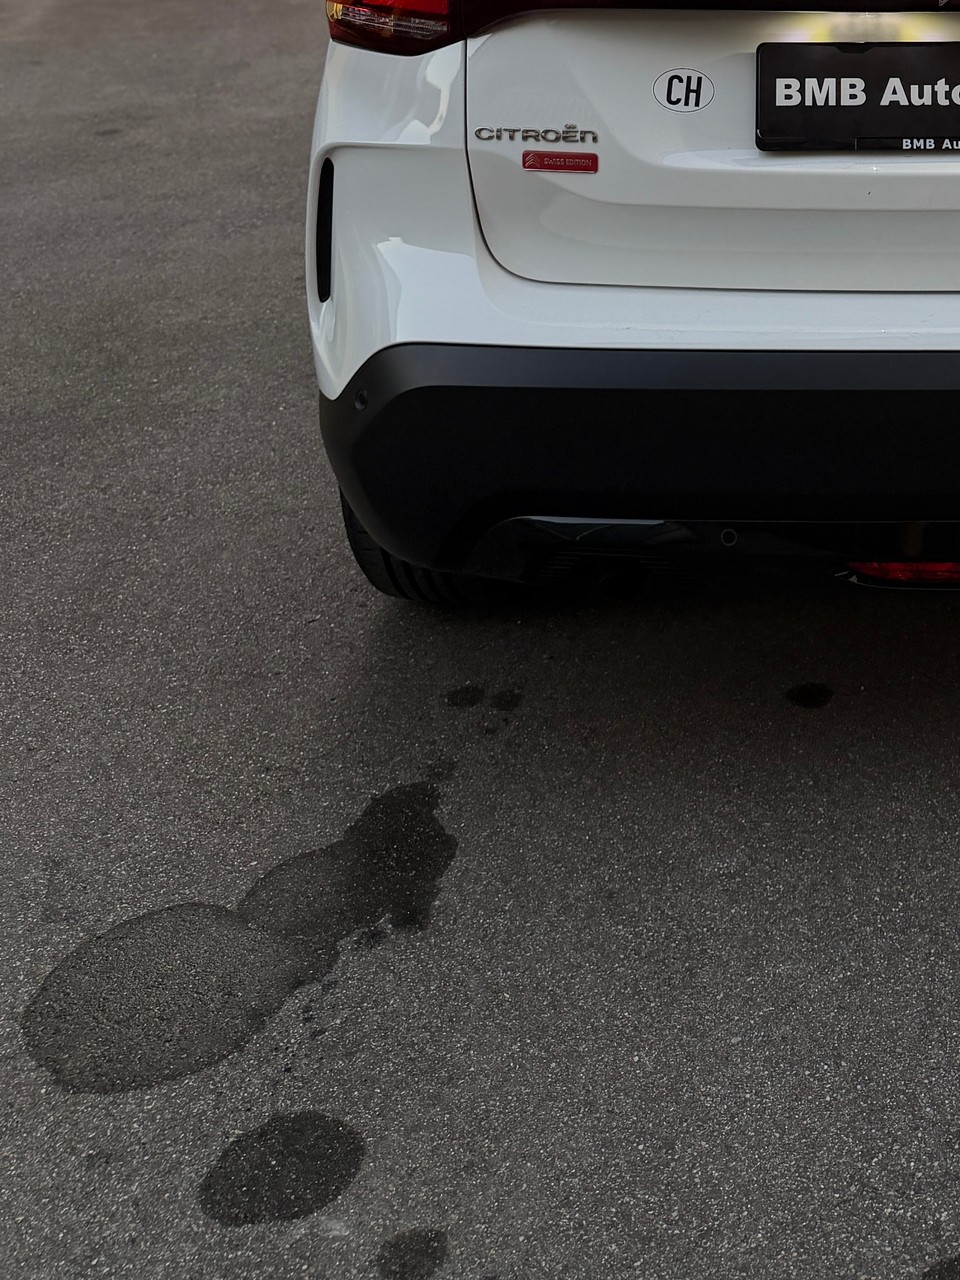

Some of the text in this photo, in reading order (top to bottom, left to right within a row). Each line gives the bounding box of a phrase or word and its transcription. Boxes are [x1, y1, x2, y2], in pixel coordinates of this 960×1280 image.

[666, 74, 703, 108] CH
[775, 77, 867, 107] BMB
[902, 138, 936, 150] BMB
[543, 157, 592, 166] SWISS EDITION
